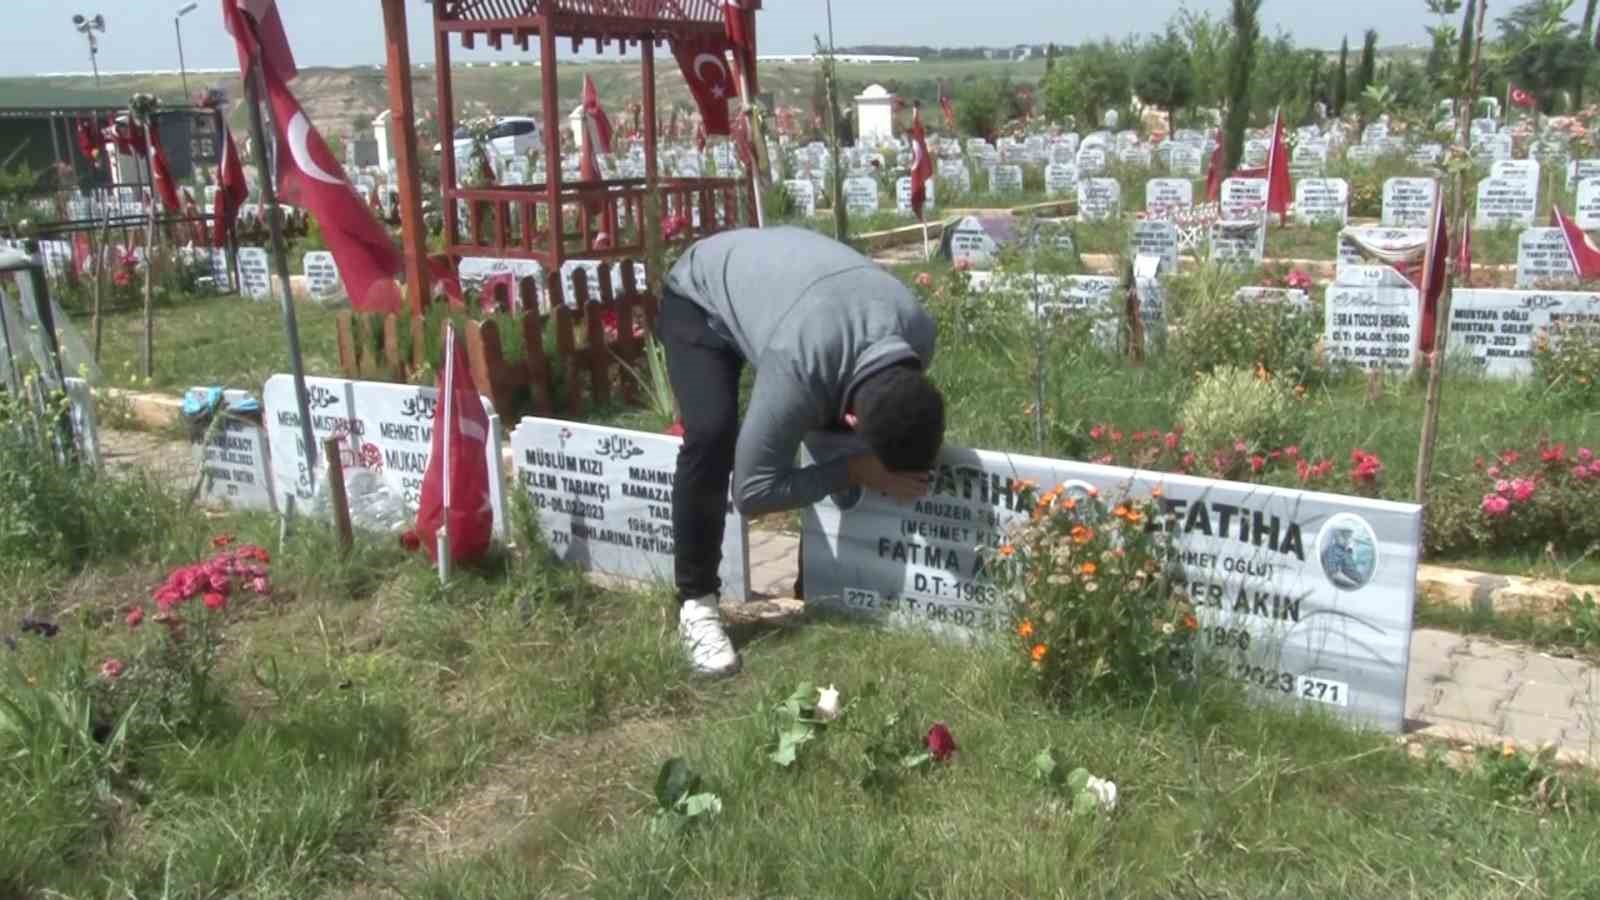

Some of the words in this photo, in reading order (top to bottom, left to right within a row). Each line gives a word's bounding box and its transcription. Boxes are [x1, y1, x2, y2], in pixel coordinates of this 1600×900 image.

[380, 421, 419, 441] MEHMET
[525, 446, 577, 472] MÜSLÜM
[579, 457, 603, 476] KIZI
[561, 476, 611, 503] TABAKÇI
[622, 483, 671, 503] RAMAZA
[879, 537, 960, 574] FATMA
[848, 591, 875, 608] 272
[953, 581, 996, 605] 1963
[1233, 583, 1302, 623] AKIN
[1303, 679, 1340, 702] 271
